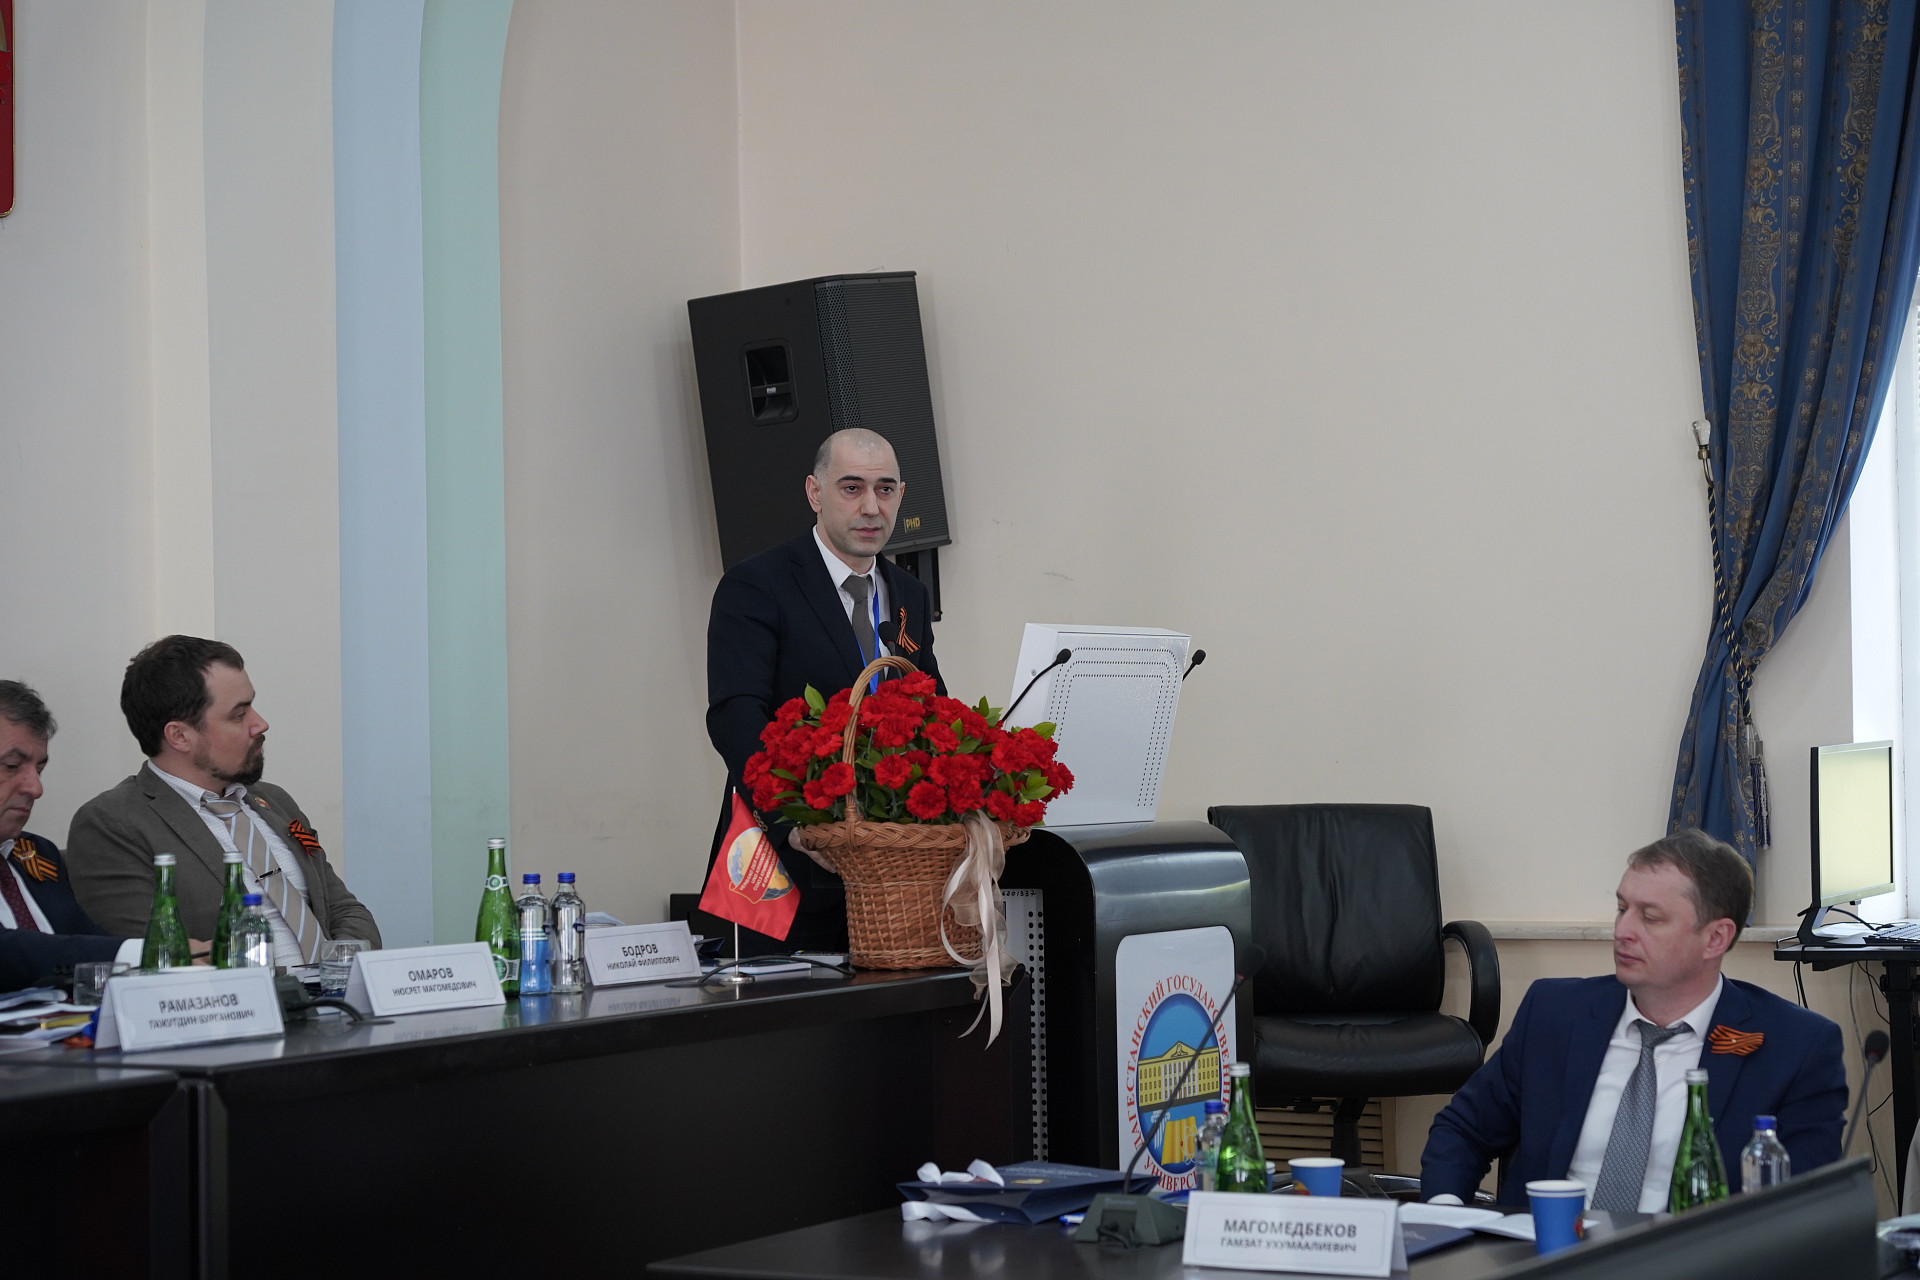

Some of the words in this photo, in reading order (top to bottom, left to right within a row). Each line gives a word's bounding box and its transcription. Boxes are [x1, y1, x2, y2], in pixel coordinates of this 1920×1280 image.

[621, 943, 659, 958] БОДРОВ
[606, 959, 637, 971] НИКОЛАЙ
[637, 955, 681, 967] ФИЛИППОВИЧ
[408, 967, 454, 982] ОМАРОВ
[392, 985, 421, 997] НЮСРЕТ
[422, 981, 477, 993] МАГОМЕДОВИЧ
[158, 993, 240, 1014] РАМАЗАНОВ
[198, 1009, 256, 1025] БУРГАНОВИЧ
[1126, 979, 1165, 1151] ДАГЕСТАНСКИЙ
[1166, 974, 1231, 1116] ГОСУДАРСТВЕННЫ
[1222, 1219, 1358, 1240] МАГОМЕДБЕКОВ
[1220, 1237, 1263, 1248] ГАМЗАТ
